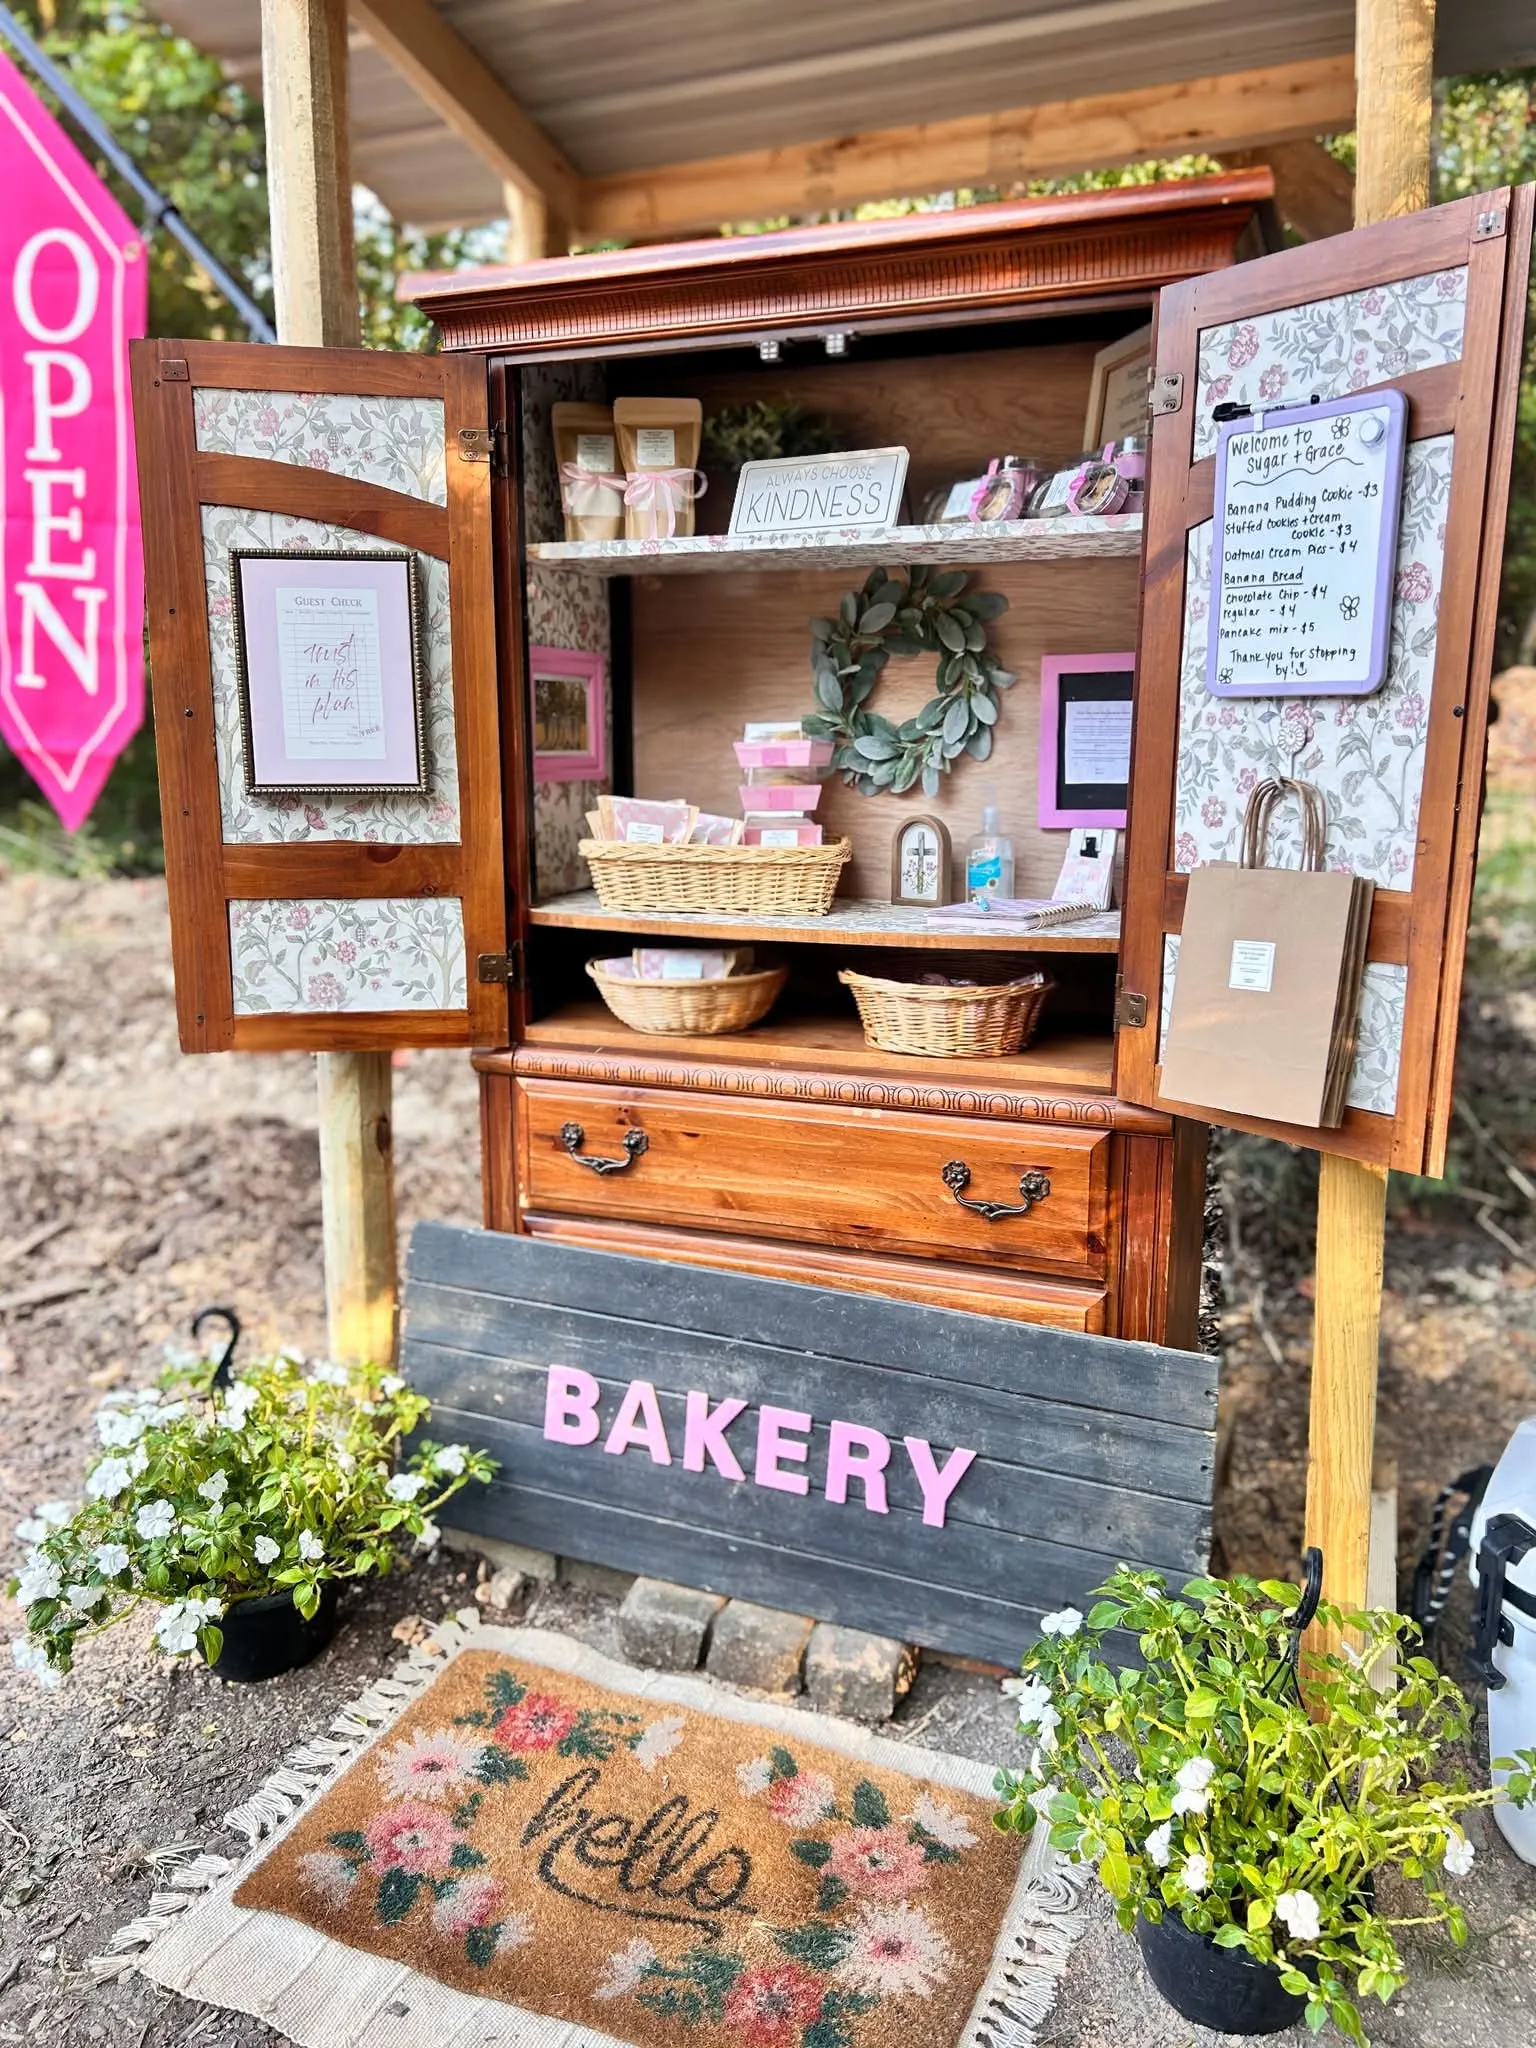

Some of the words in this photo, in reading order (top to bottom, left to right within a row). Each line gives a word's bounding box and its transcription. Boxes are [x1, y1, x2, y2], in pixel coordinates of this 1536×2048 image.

[1232, 434, 1289, 456] Welcome
[1294, 427, 1312, 443] to
[13, 227, 107, 696] OPEN
[1247, 452, 1288, 478] Sugar
[1305, 443, 1345, 464] Grace
[766, 467, 818, 489] ALWAYS
[822, 465, 876, 481] CHOOSE
[746, 482, 882, 524] KINDNESS
[1227, 502, 1269, 516] Banana
[1276, 492, 1316, 512] Pudding
[1322, 486, 1353, 501] Cookie
[1225, 549, 1264, 562] Oatmeal
[1268, 547, 1302, 559] Cream
[1308, 544, 1326, 556] Pies
[1224, 573, 1265, 585] Banana
[1272, 565, 1304, 582] Bread
[294, 596, 326, 607] GUEST
[330, 597, 363, 607] CHECK
[1226, 590, 1272, 604] Chocolate
[1279, 588, 1300, 601] Chip
[1223, 607, 1260, 623] regular
[1269, 624, 1288, 634] mix
[303, 633, 354, 666] Trust
[1230, 648, 1264, 663] Thank
[1265, 651, 1283, 668] you
[1290, 646, 1307, 660] for
[1309, 645, 1356, 662] stopping
[305, 673, 320, 688] in
[312, 691, 354, 725] plan
[543, 1363, 977, 1529] BAKERY
[520, 1767, 757, 1943] hello
